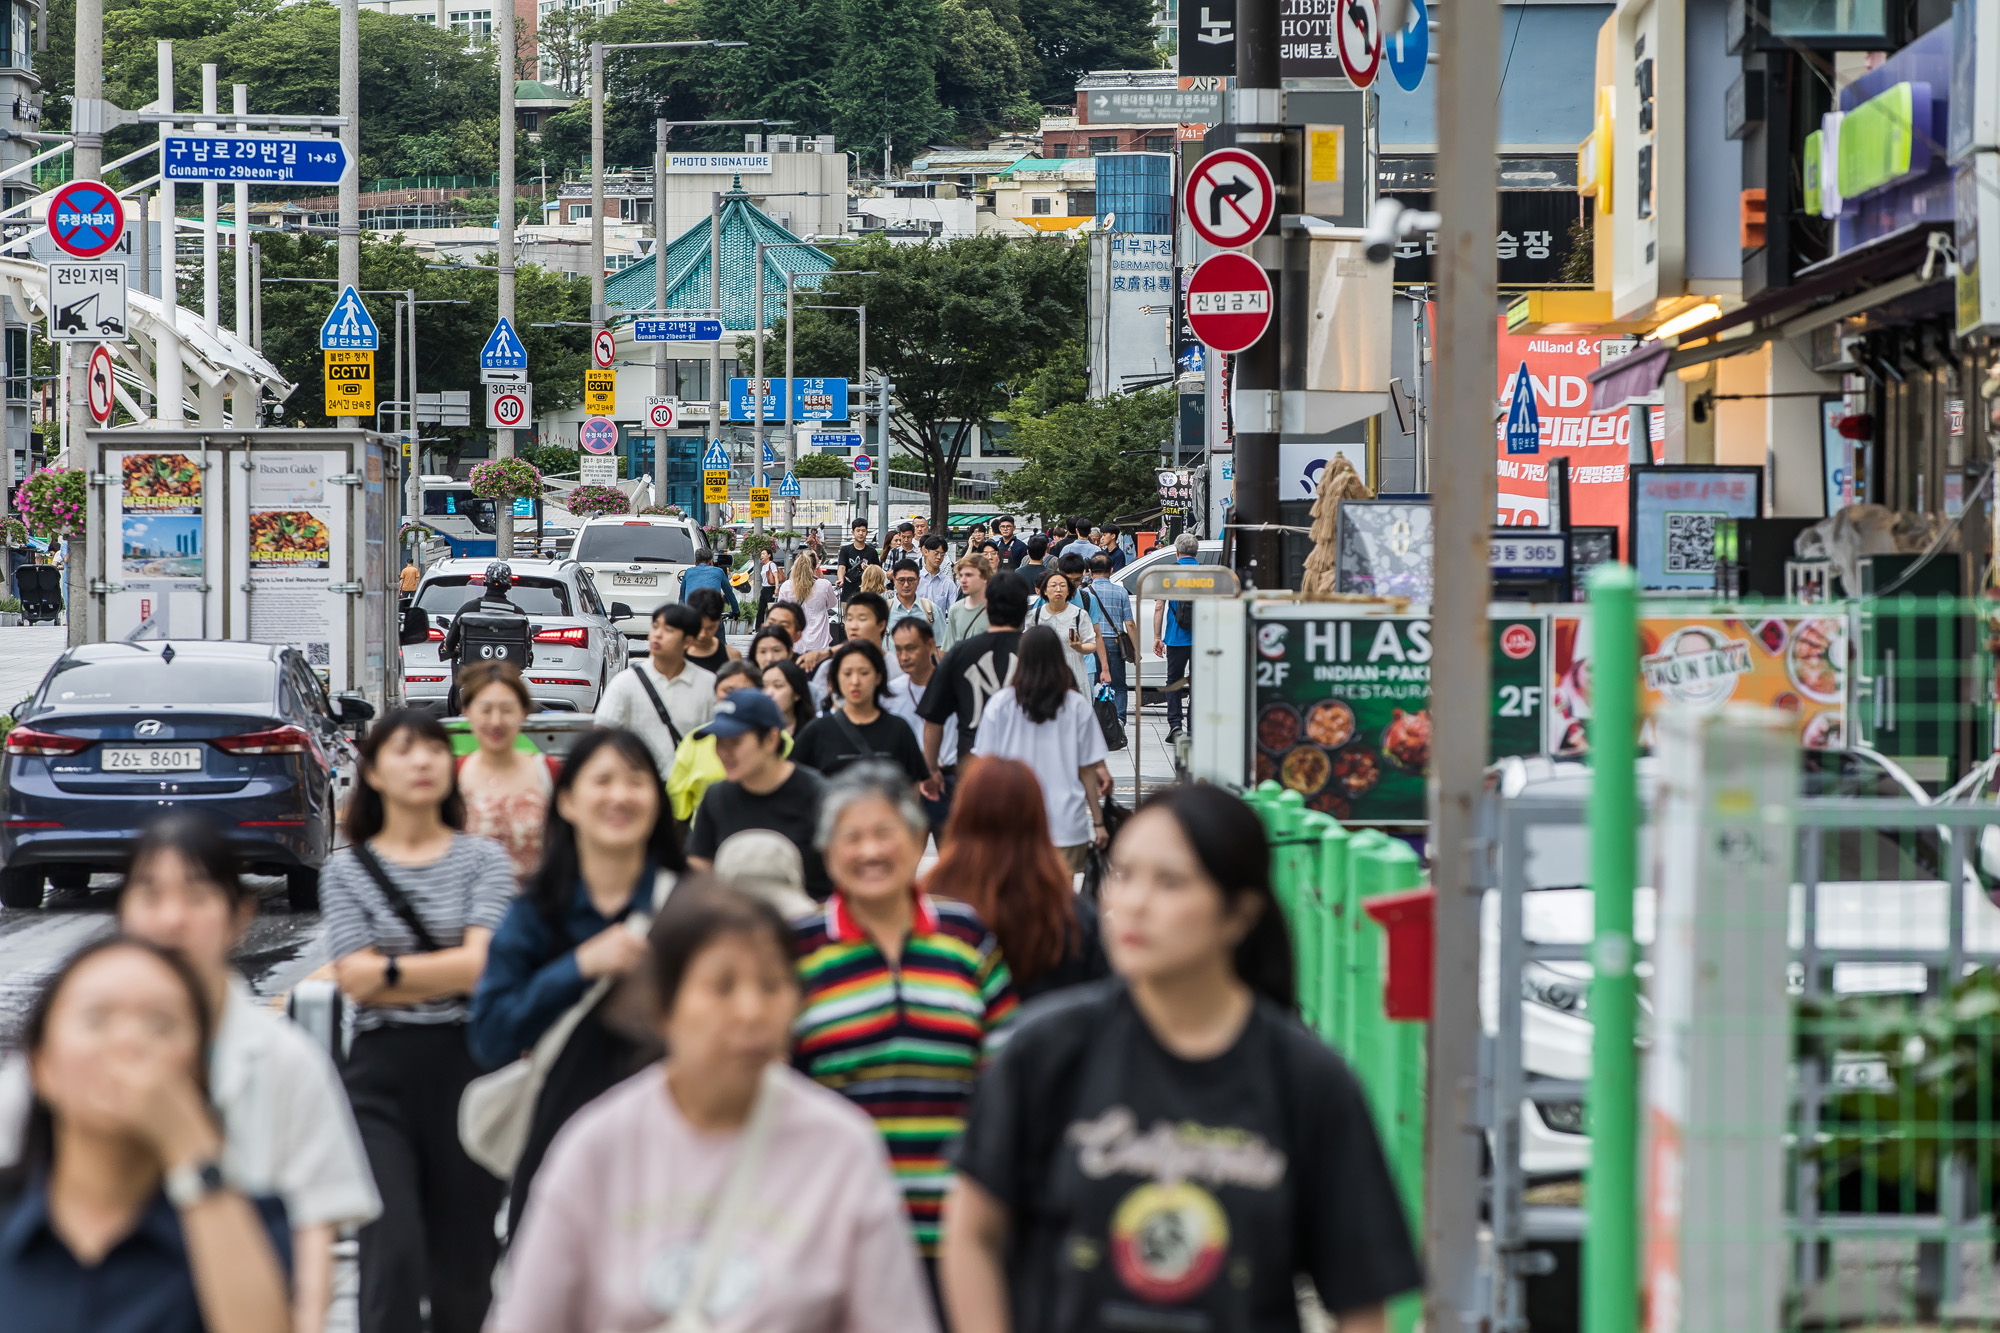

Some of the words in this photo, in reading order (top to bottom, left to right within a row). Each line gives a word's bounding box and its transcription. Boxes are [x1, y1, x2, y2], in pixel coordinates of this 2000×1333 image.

[672, 157, 707, 166] PHOTO
[710, 157, 769, 166] SIGNATURE
[168, 163, 226, 178] Gunam-ro
[229, 165, 293, 180] 29beon-gil
[57, 213, 116, 226] 주정차금지
[1112, 239, 1171, 255] 피부과전
[1112, 260, 1174, 270] DERMATOL
[57, 268, 118, 284] 견인지역
[1196, 293, 1262, 312] 진입금지
[327, 336, 374, 347] 횡단보도
[486, 358, 519, 367] 횡단보도
[331, 366, 368, 379] CCTV
[492, 384, 527, 395] 30구역
[588, 382, 612, 391] CCTV
[803, 379, 825, 390] 기장
[328, 400, 350, 411] 24시간
[352, 400, 371, 410] 단속중
[648, 397, 674, 405] 30구역
[741, 395, 776, 406] 요트기장
[804, 395, 833, 405] 해운대역
[501, 401, 518, 418] 30
[656, 410, 668, 422] 30
[585, 431, 613, 439] 주정차금지
[259, 466, 289, 474] Busan
[290, 466, 318, 474] Guide
[1523, 545, 1556, 561] 365
[634, 577, 653, 585] 4227
[1304, 621, 1352, 662] HI
[1257, 663, 1290, 688] 2F
[1498, 684, 1542, 717] 2F
[111, 752, 142, 767] 26노
[150, 752, 190, 766] 8601
